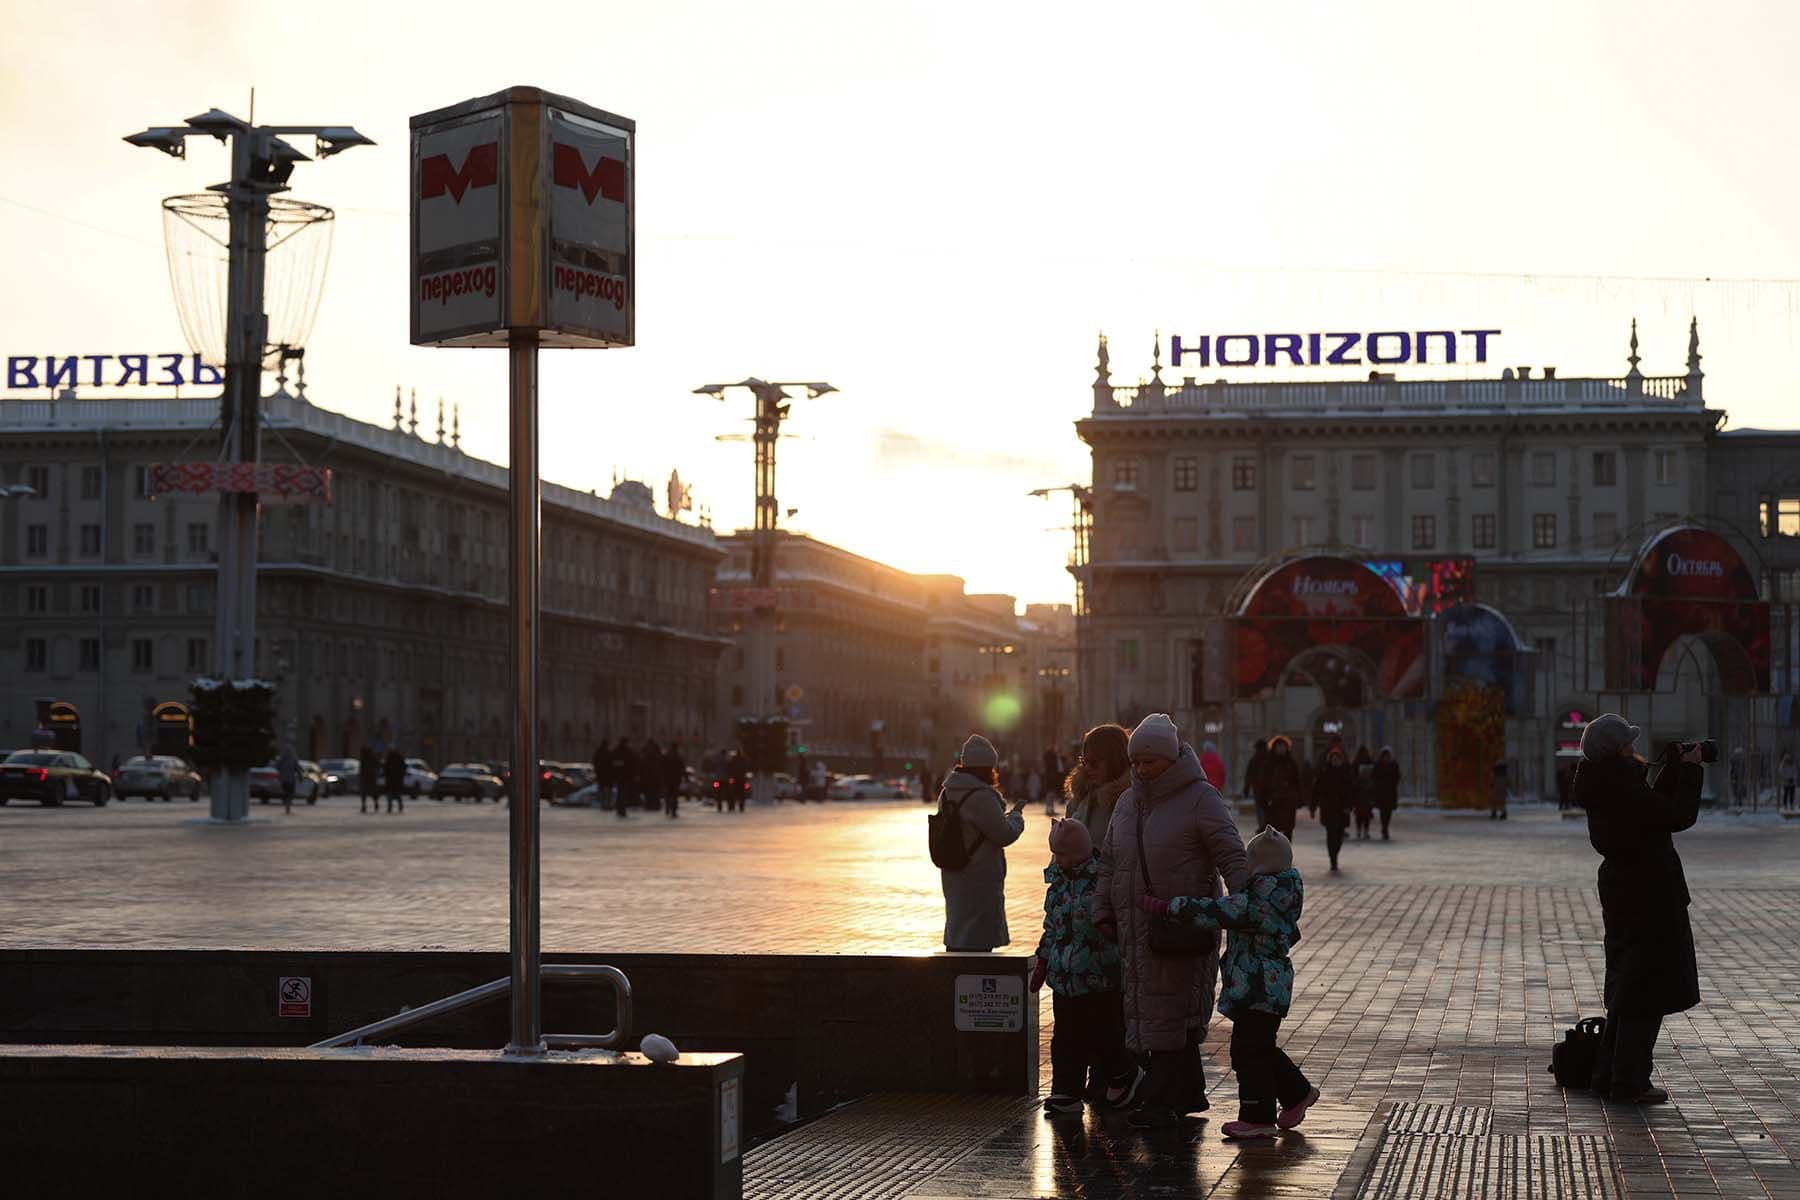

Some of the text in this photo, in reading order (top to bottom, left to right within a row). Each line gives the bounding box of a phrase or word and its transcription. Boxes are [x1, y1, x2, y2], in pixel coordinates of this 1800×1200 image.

[421, 265, 496, 305] переход
[555, 265, 625, 310] переход
[1171, 330, 1501, 367] HORIZONT
[8, 353, 224, 388] ВИТЯЗЬ
